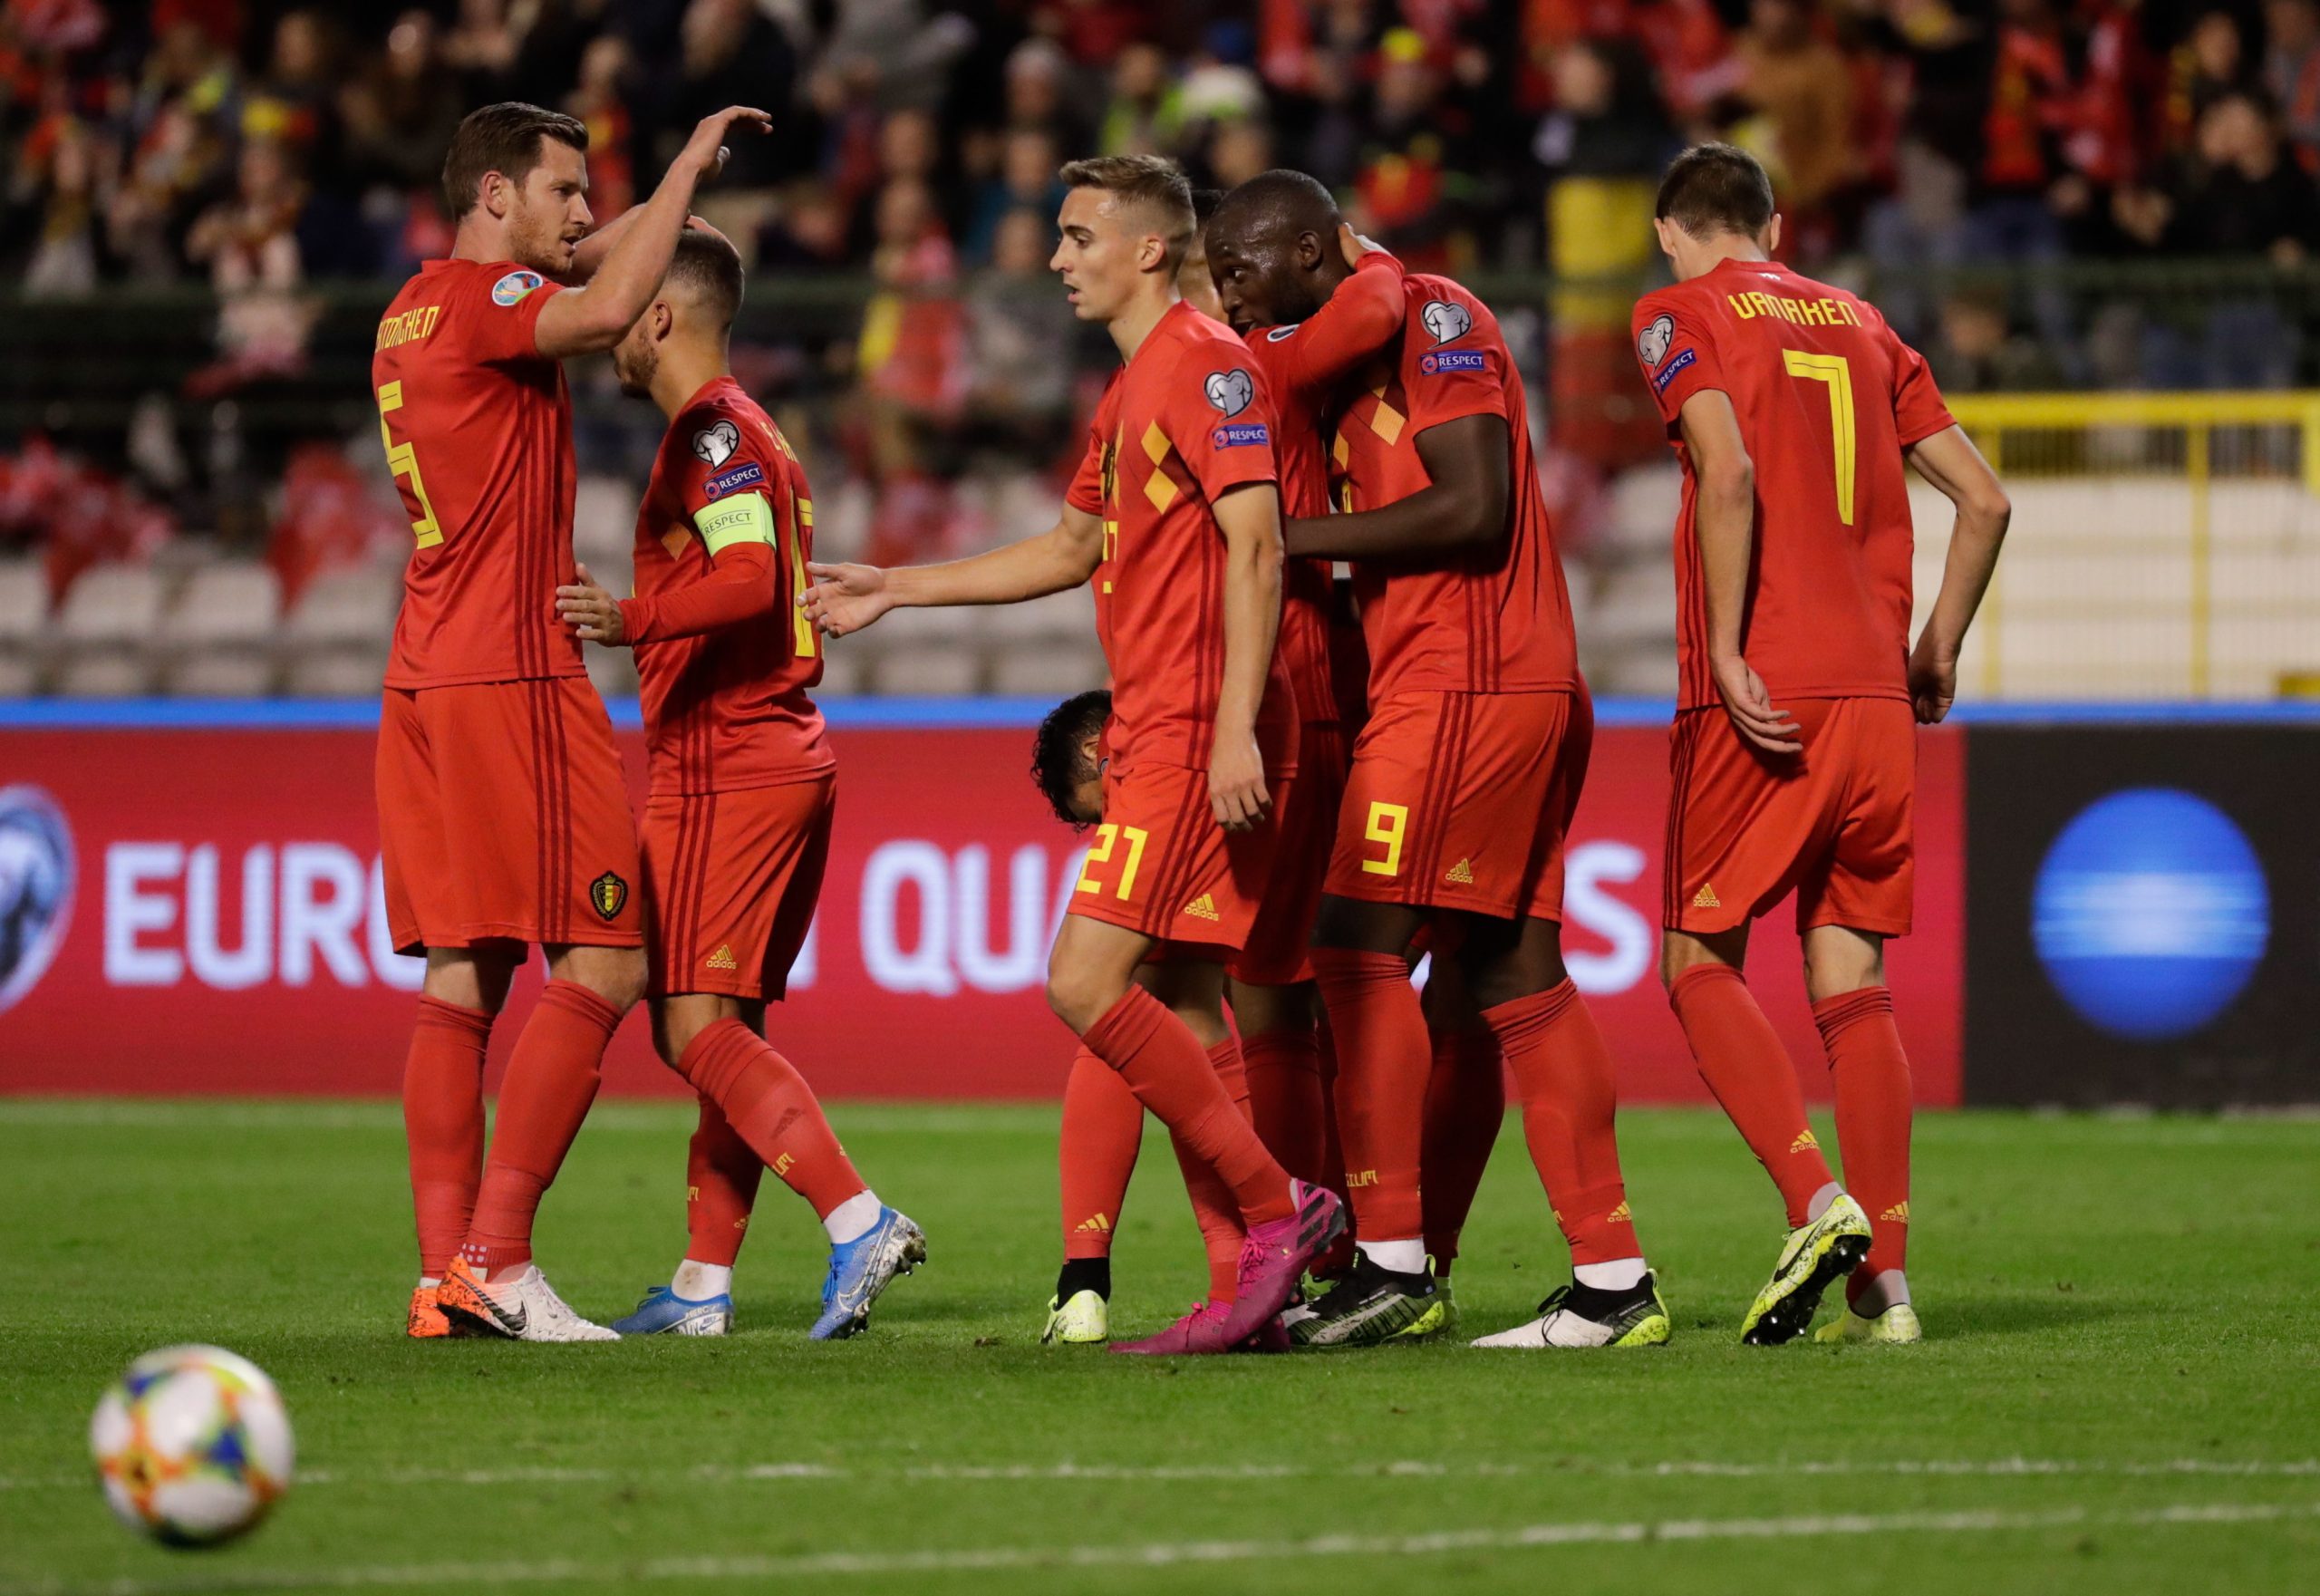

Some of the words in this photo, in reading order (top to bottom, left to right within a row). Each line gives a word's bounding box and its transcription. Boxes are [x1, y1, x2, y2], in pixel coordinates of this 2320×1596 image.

[1727, 291, 1862, 327] VANAKEN
[1438, 355, 1483, 367] RESPECT
[1662, 352, 1693, 385] RESPECT
[1228, 429, 1268, 440] RESPEC
[1782, 348, 1855, 526] 7
[378, 380, 444, 550] 5
[719, 468, 760, 489] RESPECT
[704, 512, 751, 536] RESPECT
[1361, 800, 1408, 876] 9
[1076, 823, 1148, 902] 21
[1445, 873, 1473, 884] adidas
[1184, 906, 1219, 921] adidas
[1693, 898, 1720, 907] adidas
[706, 960, 738, 970] adidas
